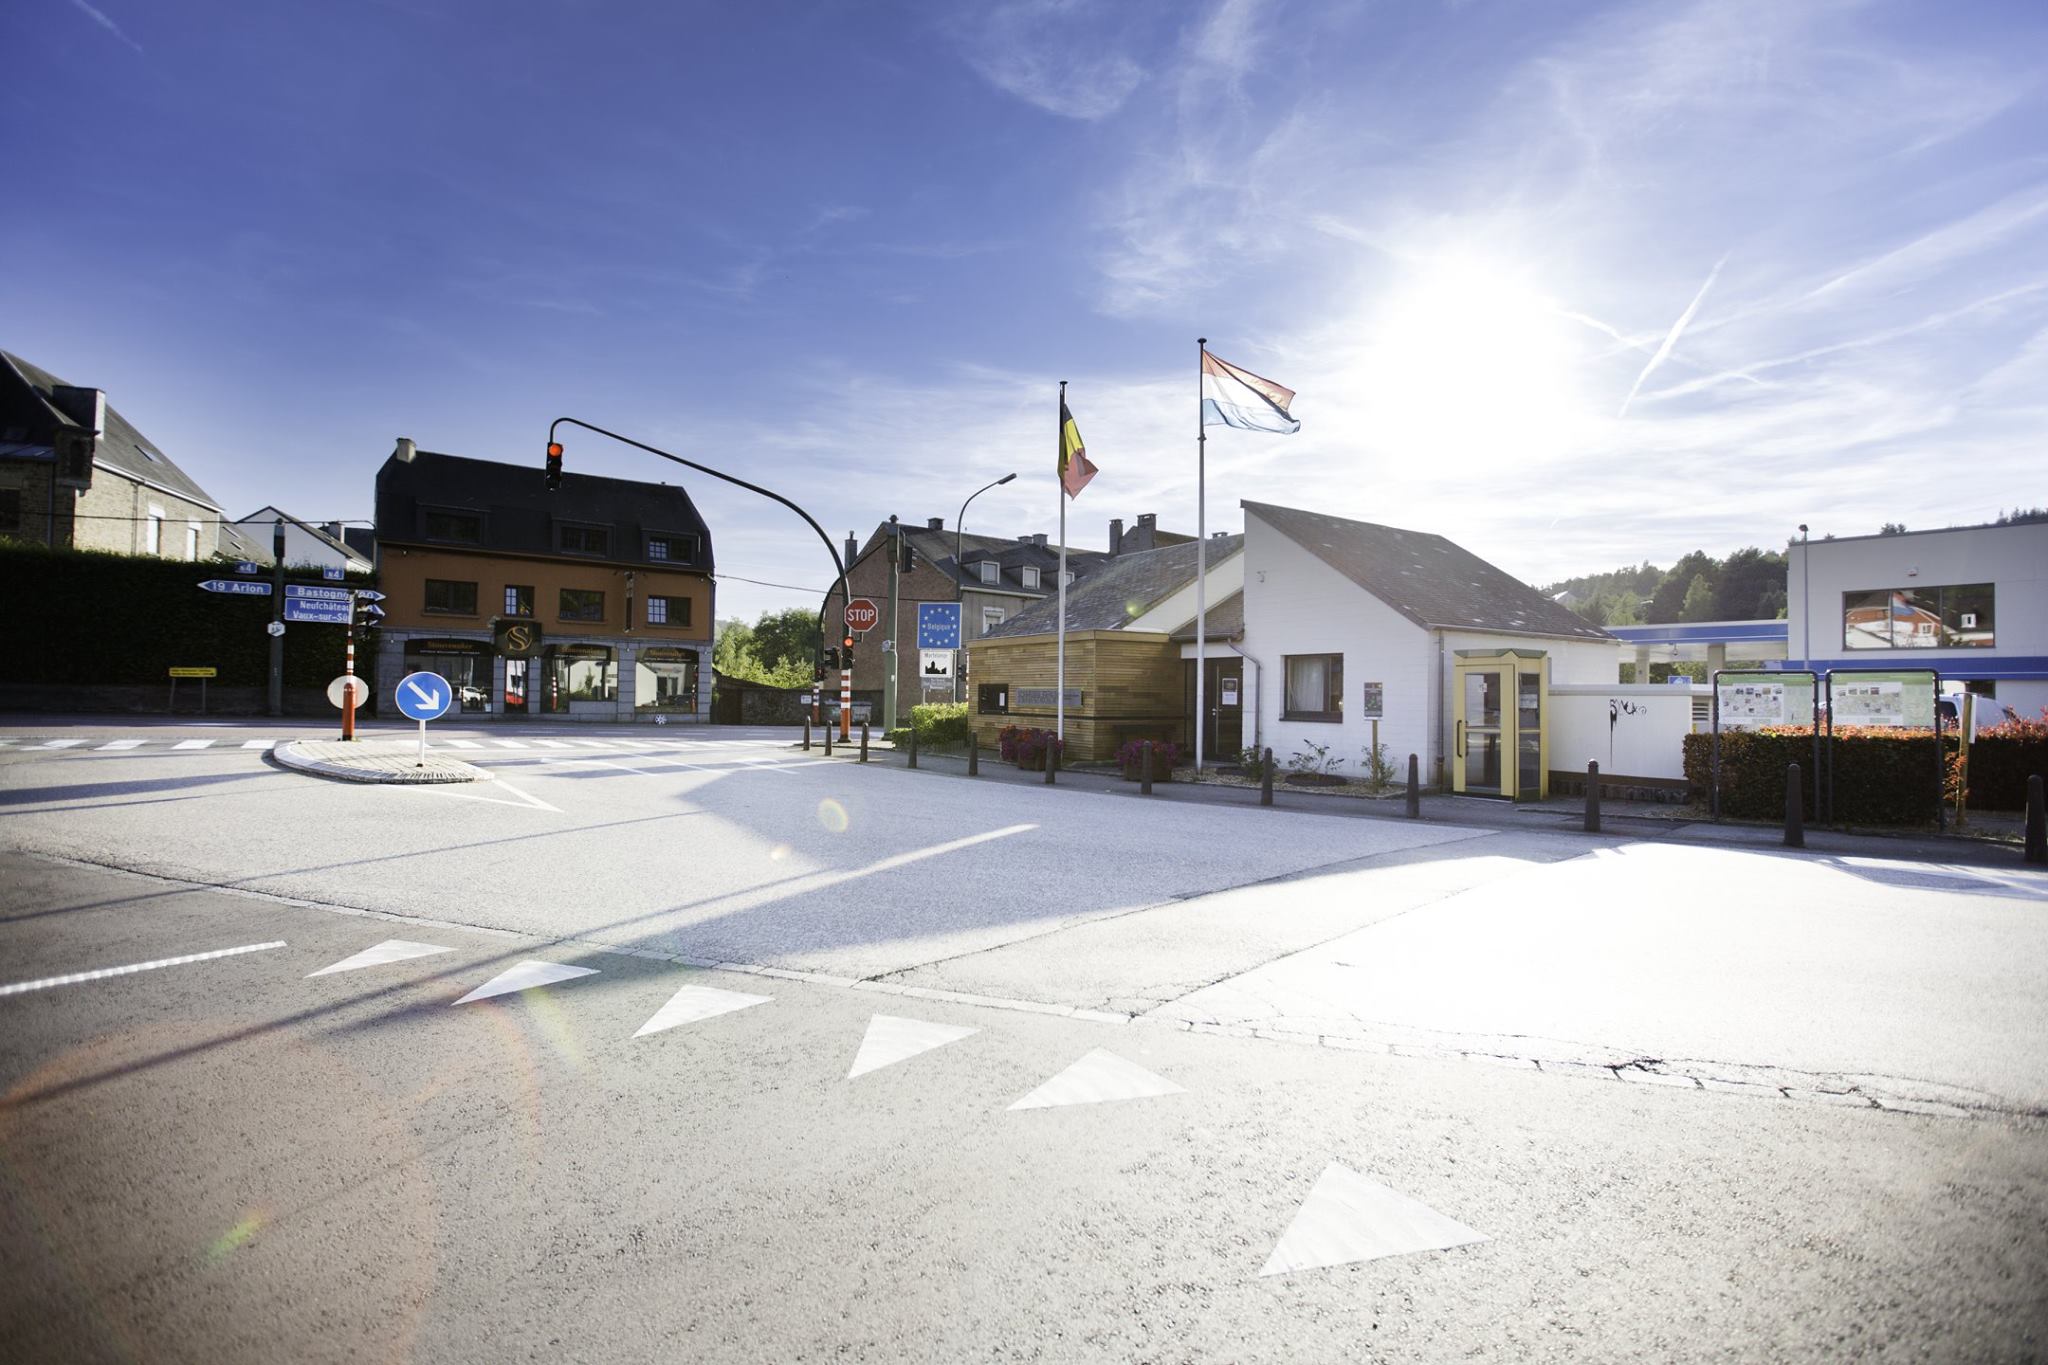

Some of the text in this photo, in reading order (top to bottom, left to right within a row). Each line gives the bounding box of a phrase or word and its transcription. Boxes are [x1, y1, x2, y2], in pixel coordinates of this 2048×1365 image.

[212, 581, 225, 591] 19
[292, 611, 348, 622] Vaux-sur-Sû
[847, 608, 875, 622] STOP
[926, 623, 951, 632] Belgique
